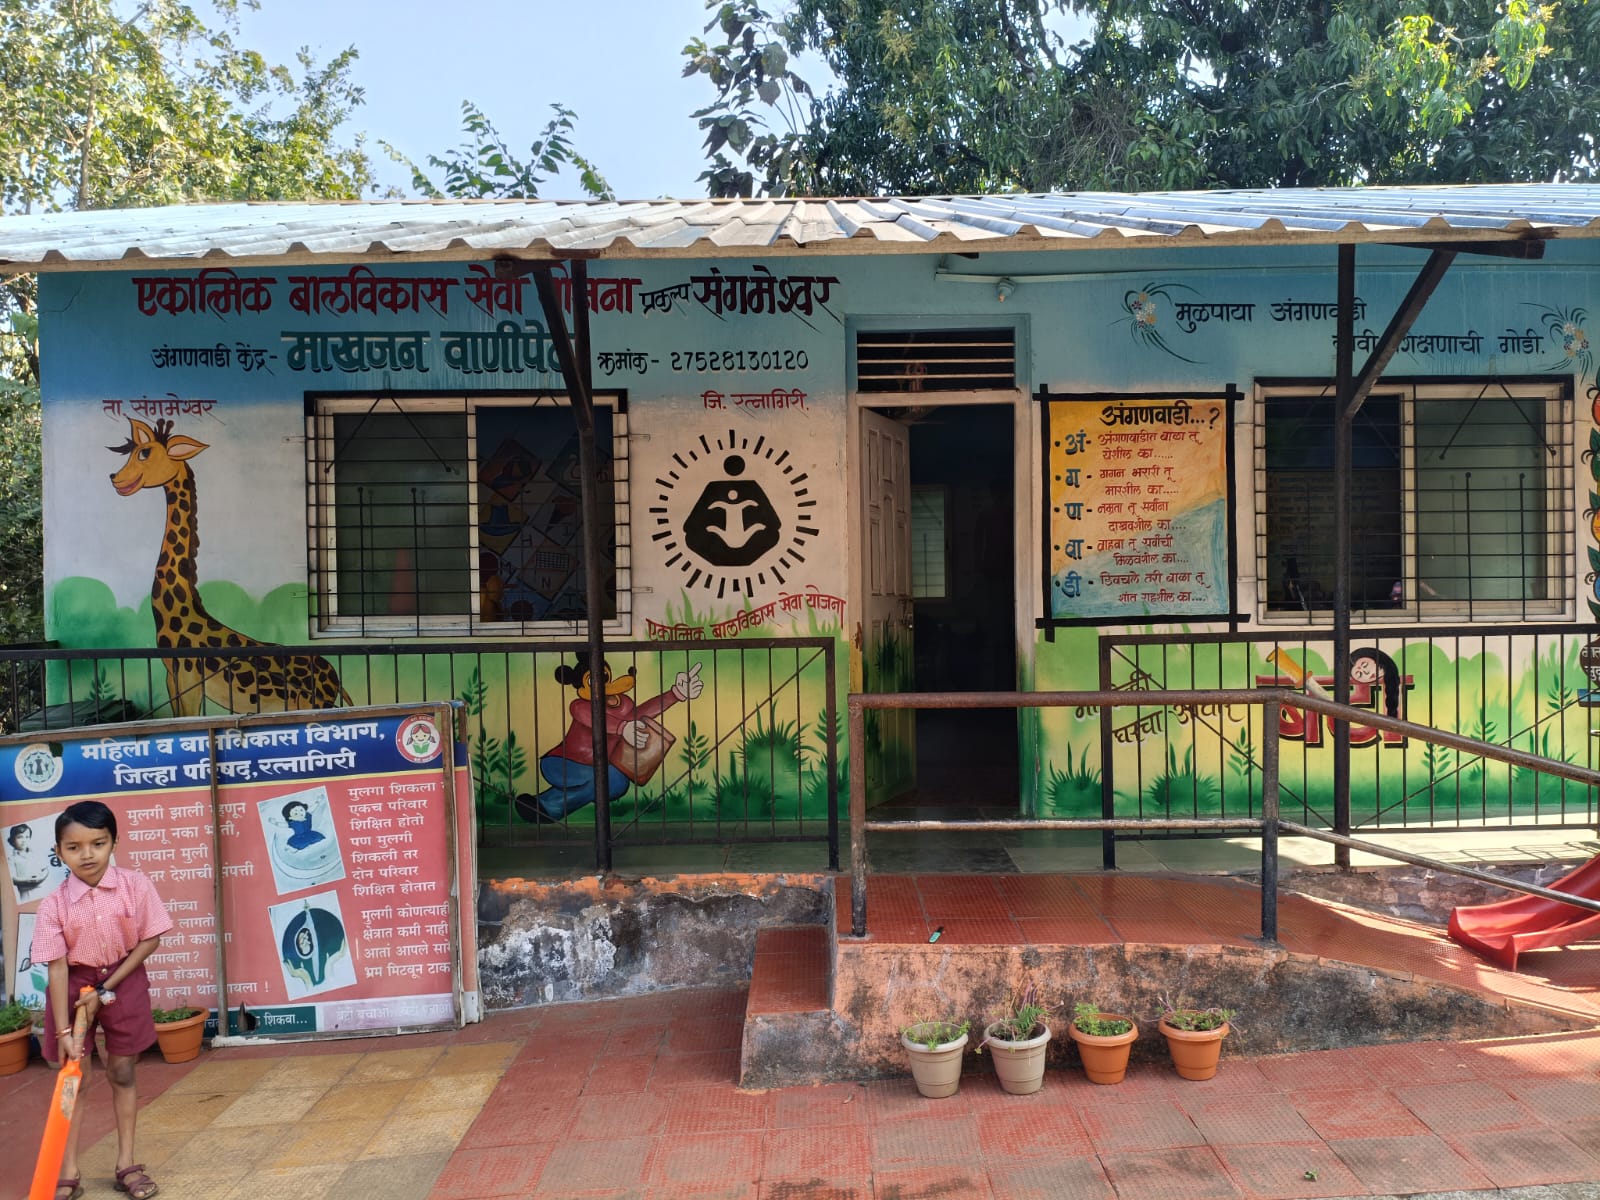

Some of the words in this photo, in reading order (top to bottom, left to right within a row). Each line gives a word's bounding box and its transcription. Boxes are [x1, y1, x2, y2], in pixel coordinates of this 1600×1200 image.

[132, 267, 278, 320] एकात्मिक
[288, 264, 459, 318] बालविकास
[464, 264, 530, 316] सेवा
[639, 283, 693, 315] प्रकल्प
[690, 265, 840, 322] संगमेश्वर
[1174, 302, 1256, 333] मुळपाया
[151, 342, 230, 369] अंगणवाडी
[281, 331, 430, 373] माखजन
[671, 350, 808, 371] 27528130120
[129, 392, 218, 419] संगमेश्वर
[700, 390, 726, 409] जि.
[1189, 431, 1203, 445] तू
[1132, 465, 1161, 480] भरारी
[1164, 466, 1177, 482] तू
[1128, 502, 1139, 517] तू
[1128, 538, 1139, 554] तू
[1144, 569, 1163, 585] तरी
[1195, 571, 1212, 588] तू
[645, 618, 706, 641] एकात्मिक
[709, 602, 777, 639] बालविकास
[778, 592, 803, 613] सेवा
[805, 585, 847, 629] योजना
[81, 737, 150, 762] महिला
[156, 738, 174, 755] व
[180, 727, 299, 754] बालविकास
[304, 722, 385, 743] विभाग,
[113, 763, 178, 786] जिल्हा
[258, 748, 357, 776] रत्नागिरी
[347, 786, 385, 802] मुलगा
[389, 782, 436, 796] शिकला
[126, 803, 165, 826] मुलगी
[169, 801, 205, 820] झाली
[348, 802, 383, 817] एकच
[387, 799, 429, 812] परिवार
[350, 816, 392, 831] शिक्षित
[397, 812, 425, 828] होतो
[128, 828, 170, 844] बाळगू
[170, 826, 199, 840] नका
[350, 836, 372, 847] पण
[376, 830, 413, 849] मुलगी
[129, 849, 176, 867] गुणवान
[180, 842, 209, 864] मुली
[351, 849, 398, 864] शिकली
[402, 849, 419, 860] तर
[149, 871, 166, 883] तर
[171, 863, 213, 883] देशाची
[352, 866, 374, 881] दोन
[378, 864, 419, 878] परिवार
[353, 882, 395, 897] शिक्षित
[399, 880, 436, 895] होतात
[361, 905, 393, 925] मुलगी
[362, 924, 393, 942] क्षेत्रात
[397, 921, 421, 938] कमी
[425, 920, 449, 937] नाही
[395, 940, 429, 956] आपले
[386, 962, 424, 980] मिटवून
